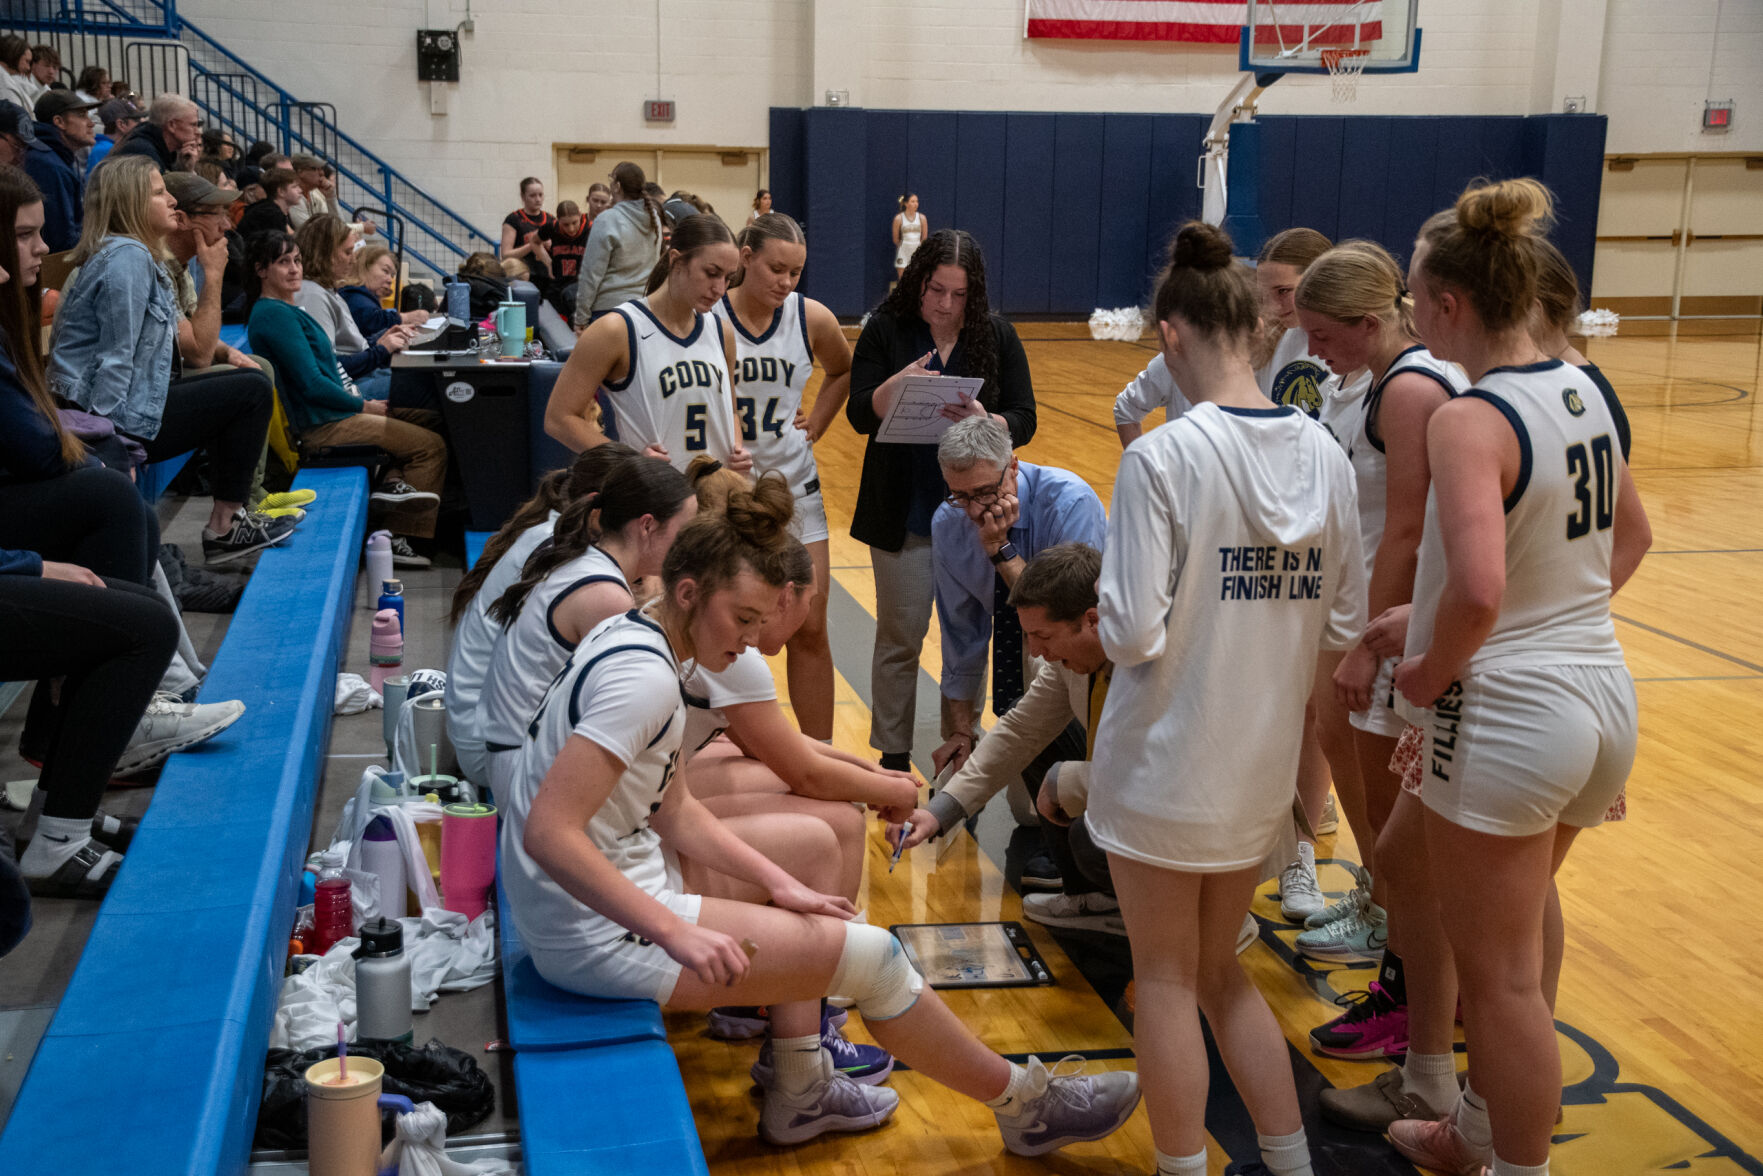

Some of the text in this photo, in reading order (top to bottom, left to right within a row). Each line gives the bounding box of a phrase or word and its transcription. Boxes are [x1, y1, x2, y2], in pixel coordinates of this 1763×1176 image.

[651, 102, 670, 118] EXIT
[658, 360, 723, 399] CODY
[685, 403, 707, 451] 5
[735, 396, 785, 441] 34
[1566, 432, 1613, 542] 30
[1218, 546, 1322, 572] THERE IS N
[1220, 575, 1323, 601] FINISH LINE
[1431, 680, 1463, 782] FILLIES
